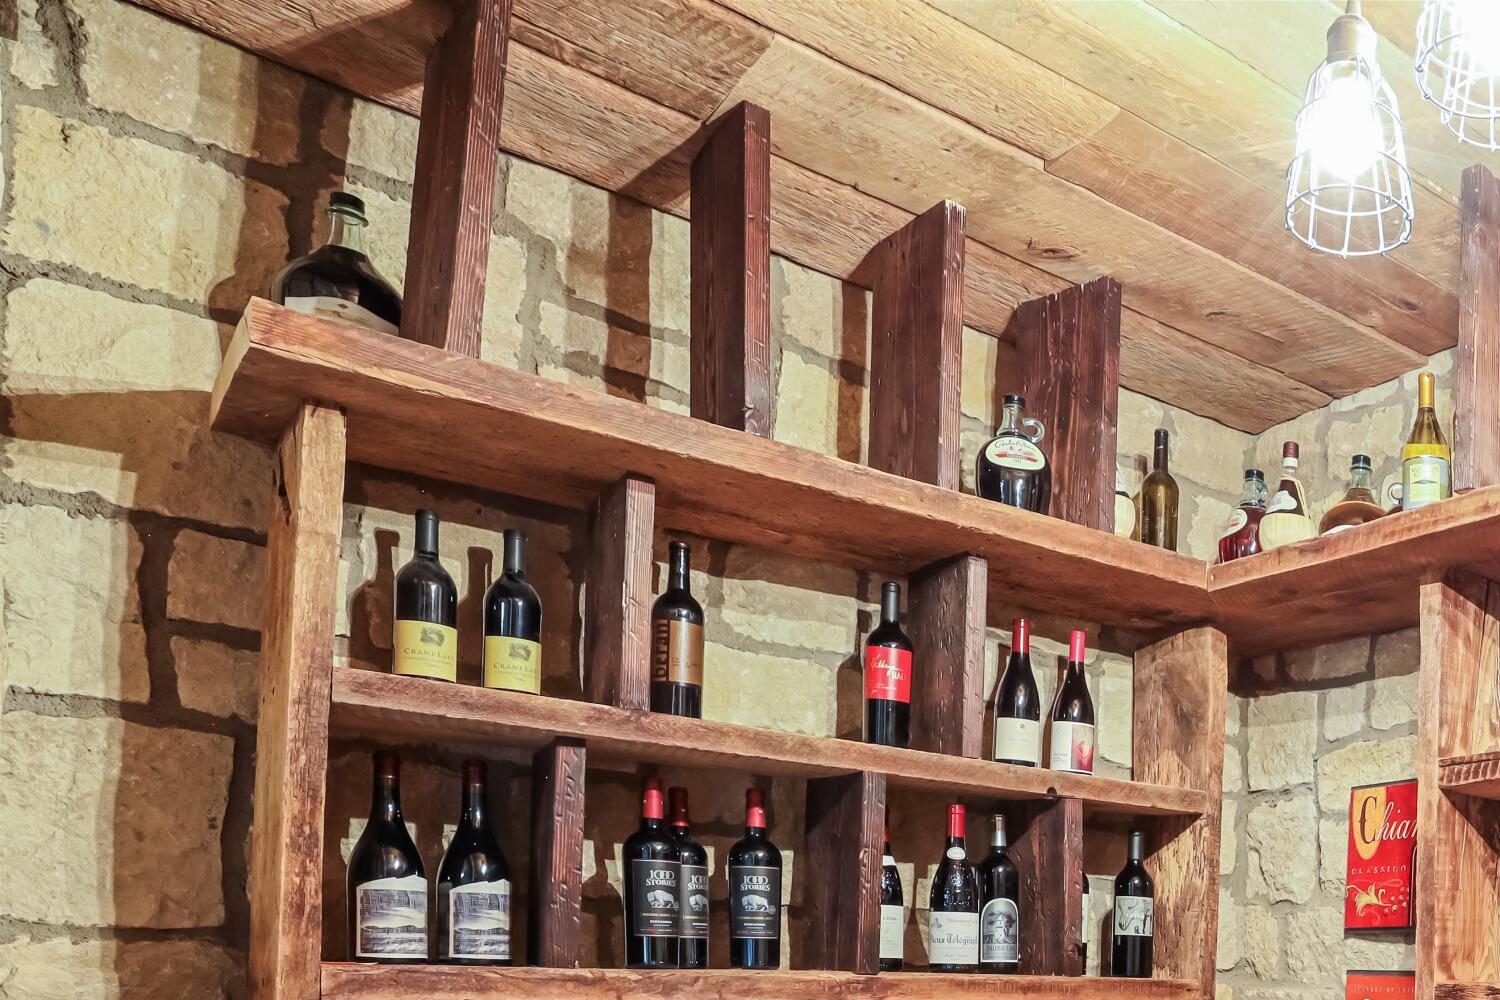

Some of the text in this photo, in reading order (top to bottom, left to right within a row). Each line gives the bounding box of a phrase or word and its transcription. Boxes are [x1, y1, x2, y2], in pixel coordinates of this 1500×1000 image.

[1351, 864, 1407, 875] CLASSICO
[645, 878, 677, 888] STORIES
[740, 883, 771, 892] STORIES
